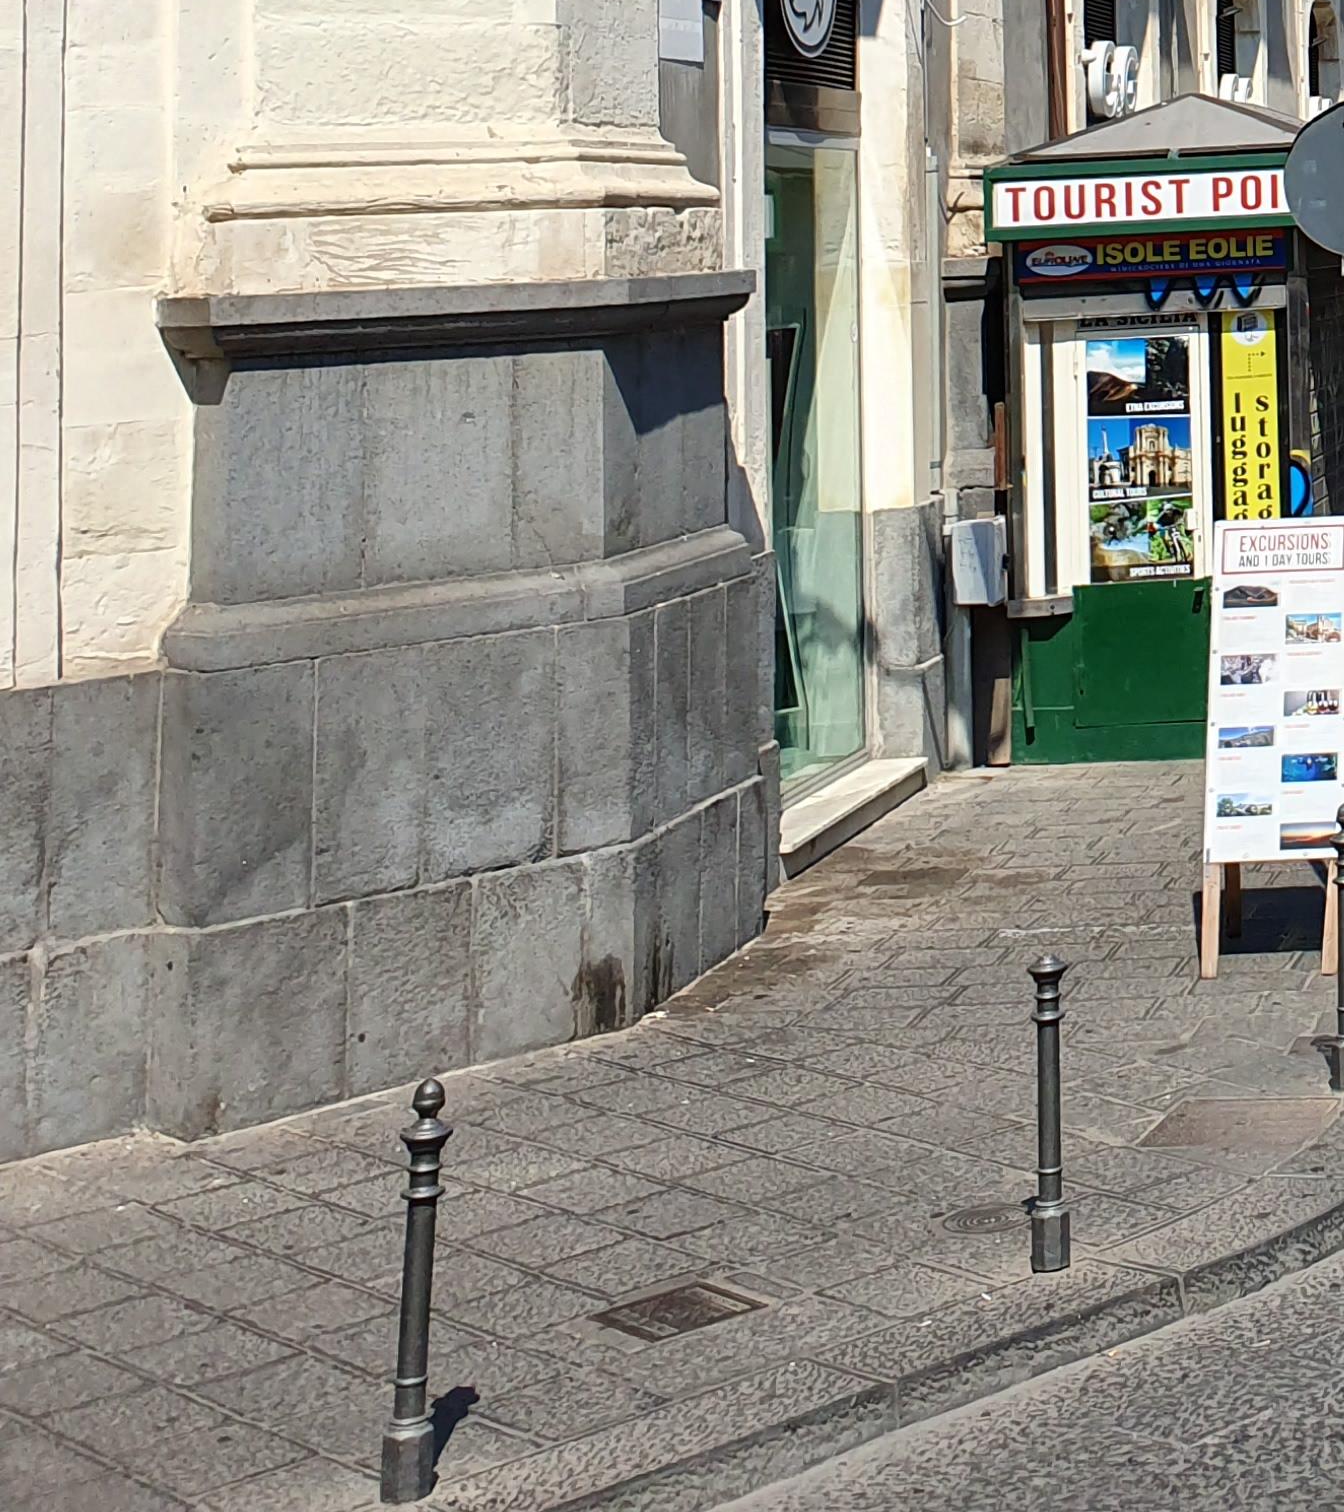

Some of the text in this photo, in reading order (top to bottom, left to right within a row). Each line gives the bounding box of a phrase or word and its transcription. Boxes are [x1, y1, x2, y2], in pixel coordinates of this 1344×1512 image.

[1005, 179, 1190, 222] TOURIST
[1096, 235, 1275, 266] ISOLE EOLIE
[1239, 532, 1330, 553] EXCURSIONS
[1238, 554, 1260, 568] AND
[1272, 553, 1293, 567] DAY
[1296, 551, 1329, 566] TOURS
